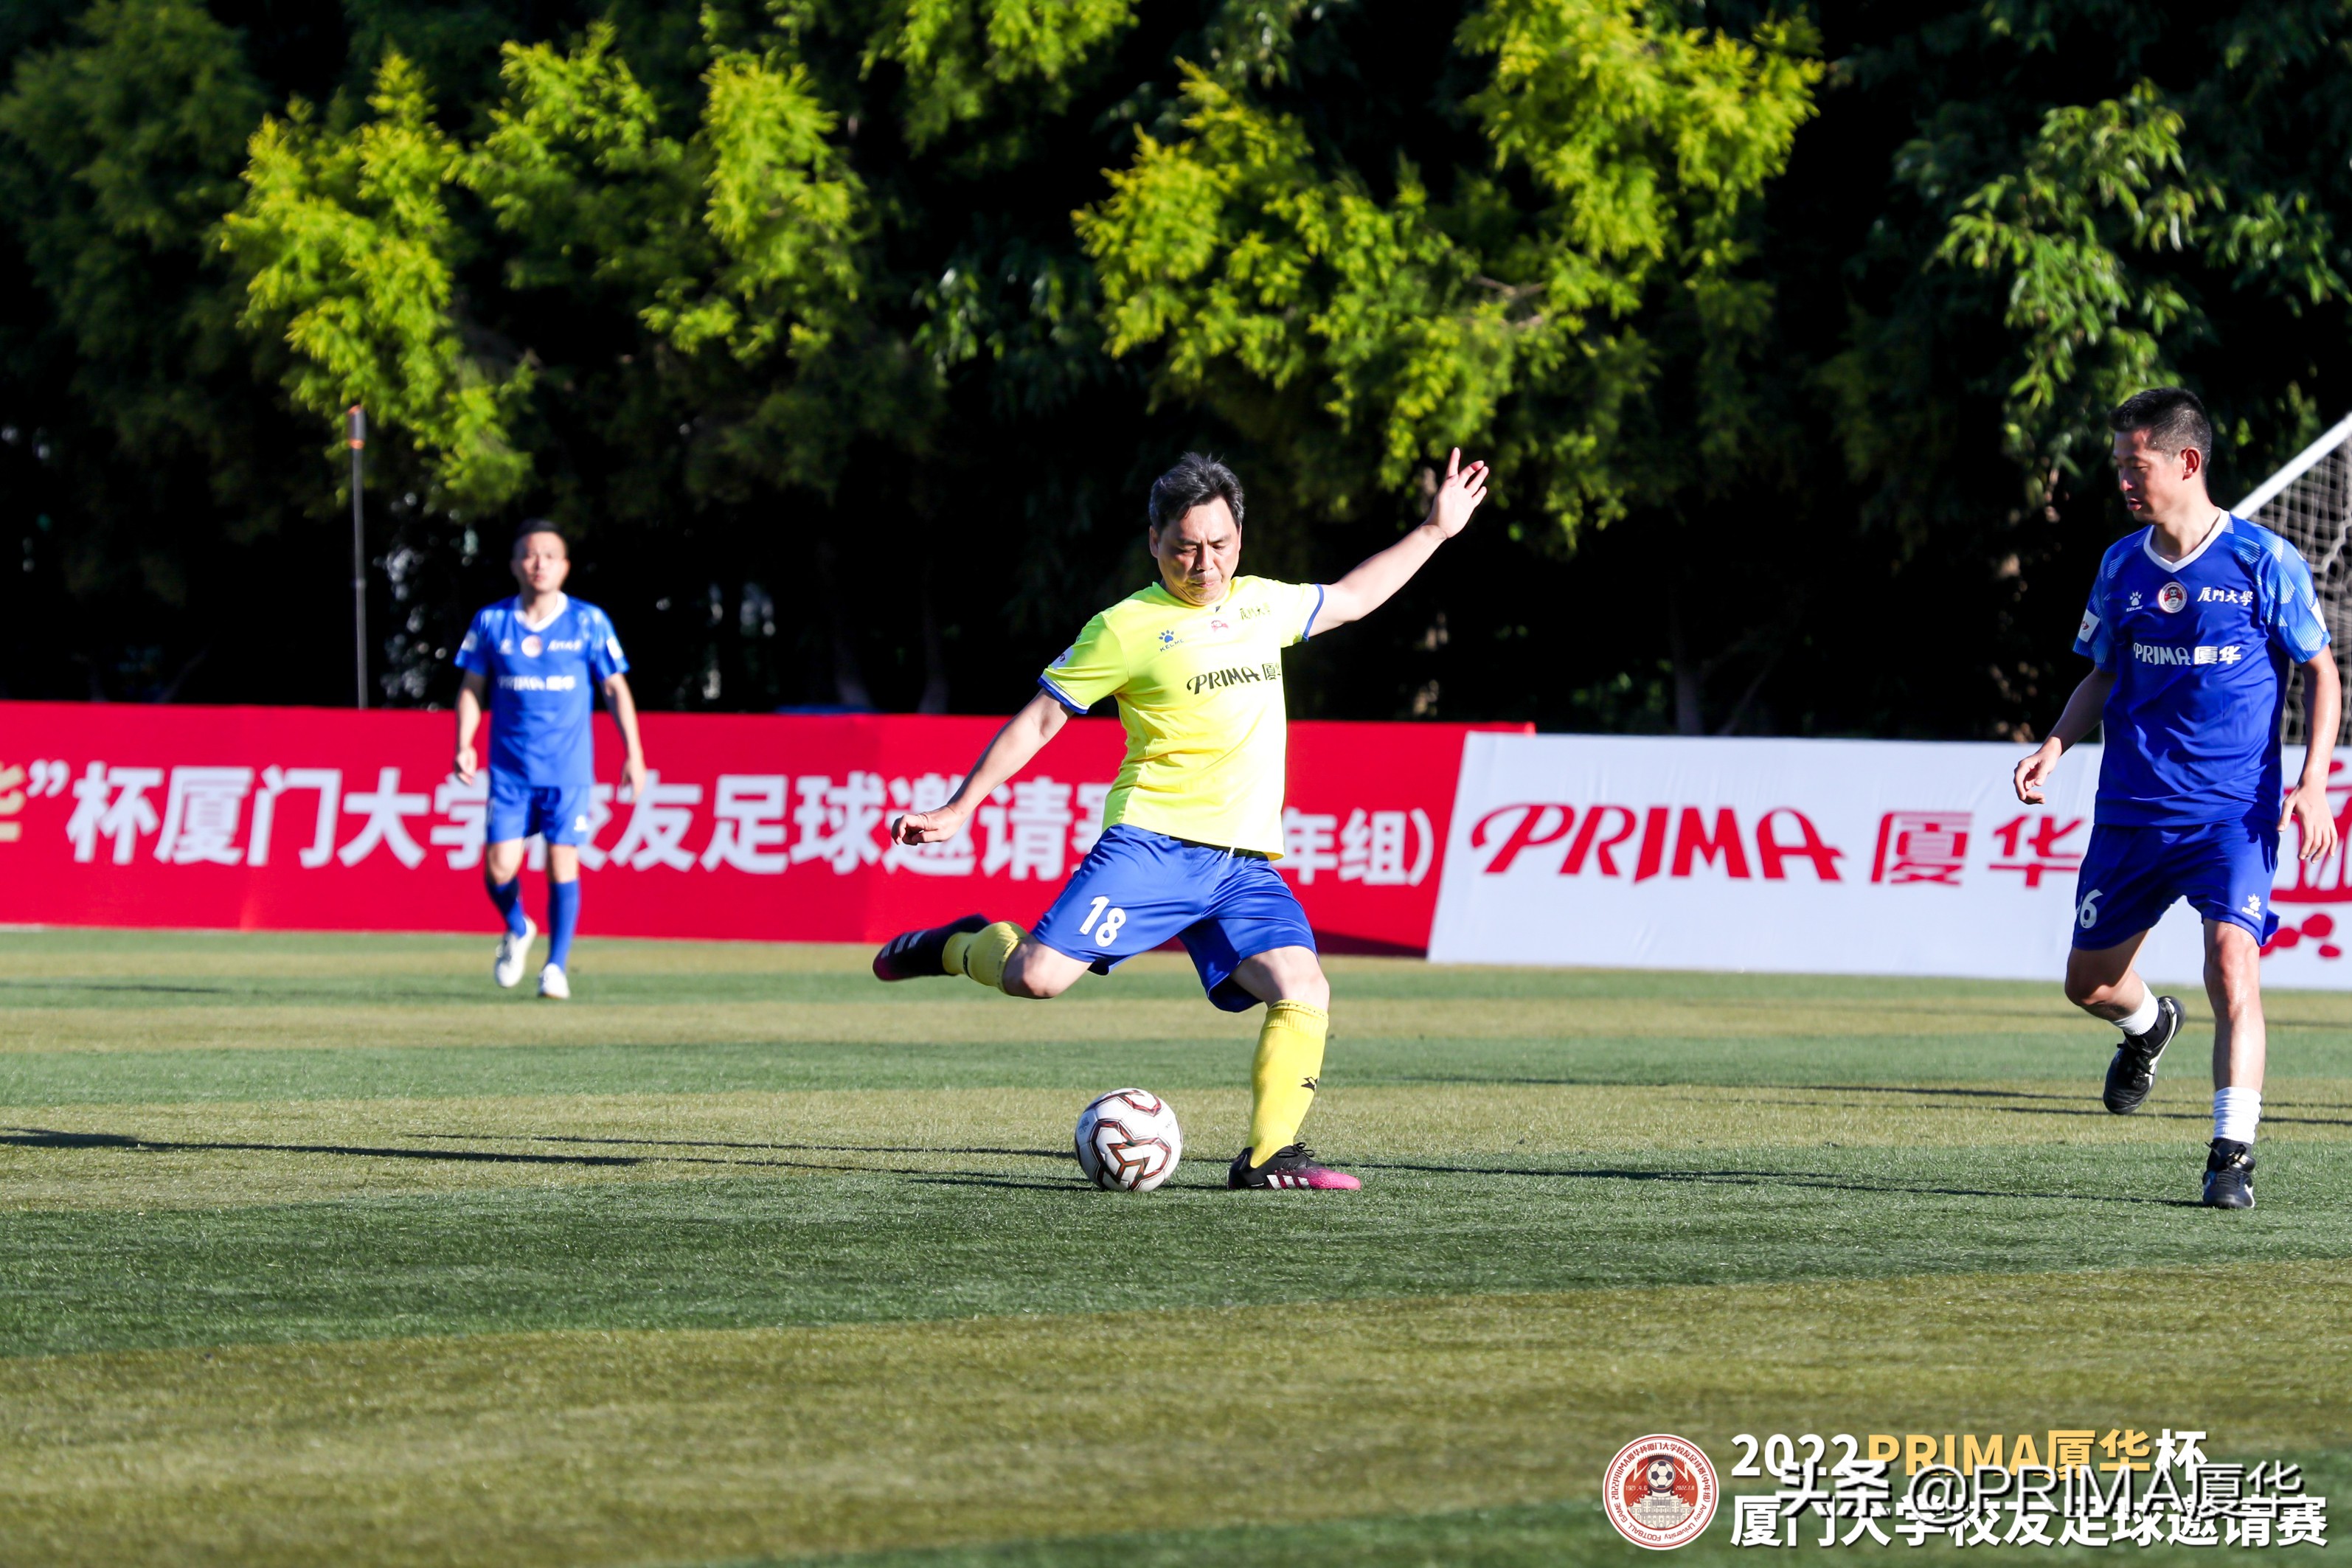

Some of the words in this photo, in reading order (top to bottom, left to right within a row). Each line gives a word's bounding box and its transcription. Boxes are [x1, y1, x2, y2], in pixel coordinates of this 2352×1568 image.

[1159, 639, 1184, 652] KELME
[2133, 642, 2191, 665] PRIMA
[2194, 645, 2242, 665] 厦华
[1186, 667, 1260, 695] PRIMA
[1470, 802, 1846, 884] PRIMA
[1869, 810, 2086, 889] 厦华
[1079, 895, 1127, 948] 18
[2076, 889, 2103, 929] 6
